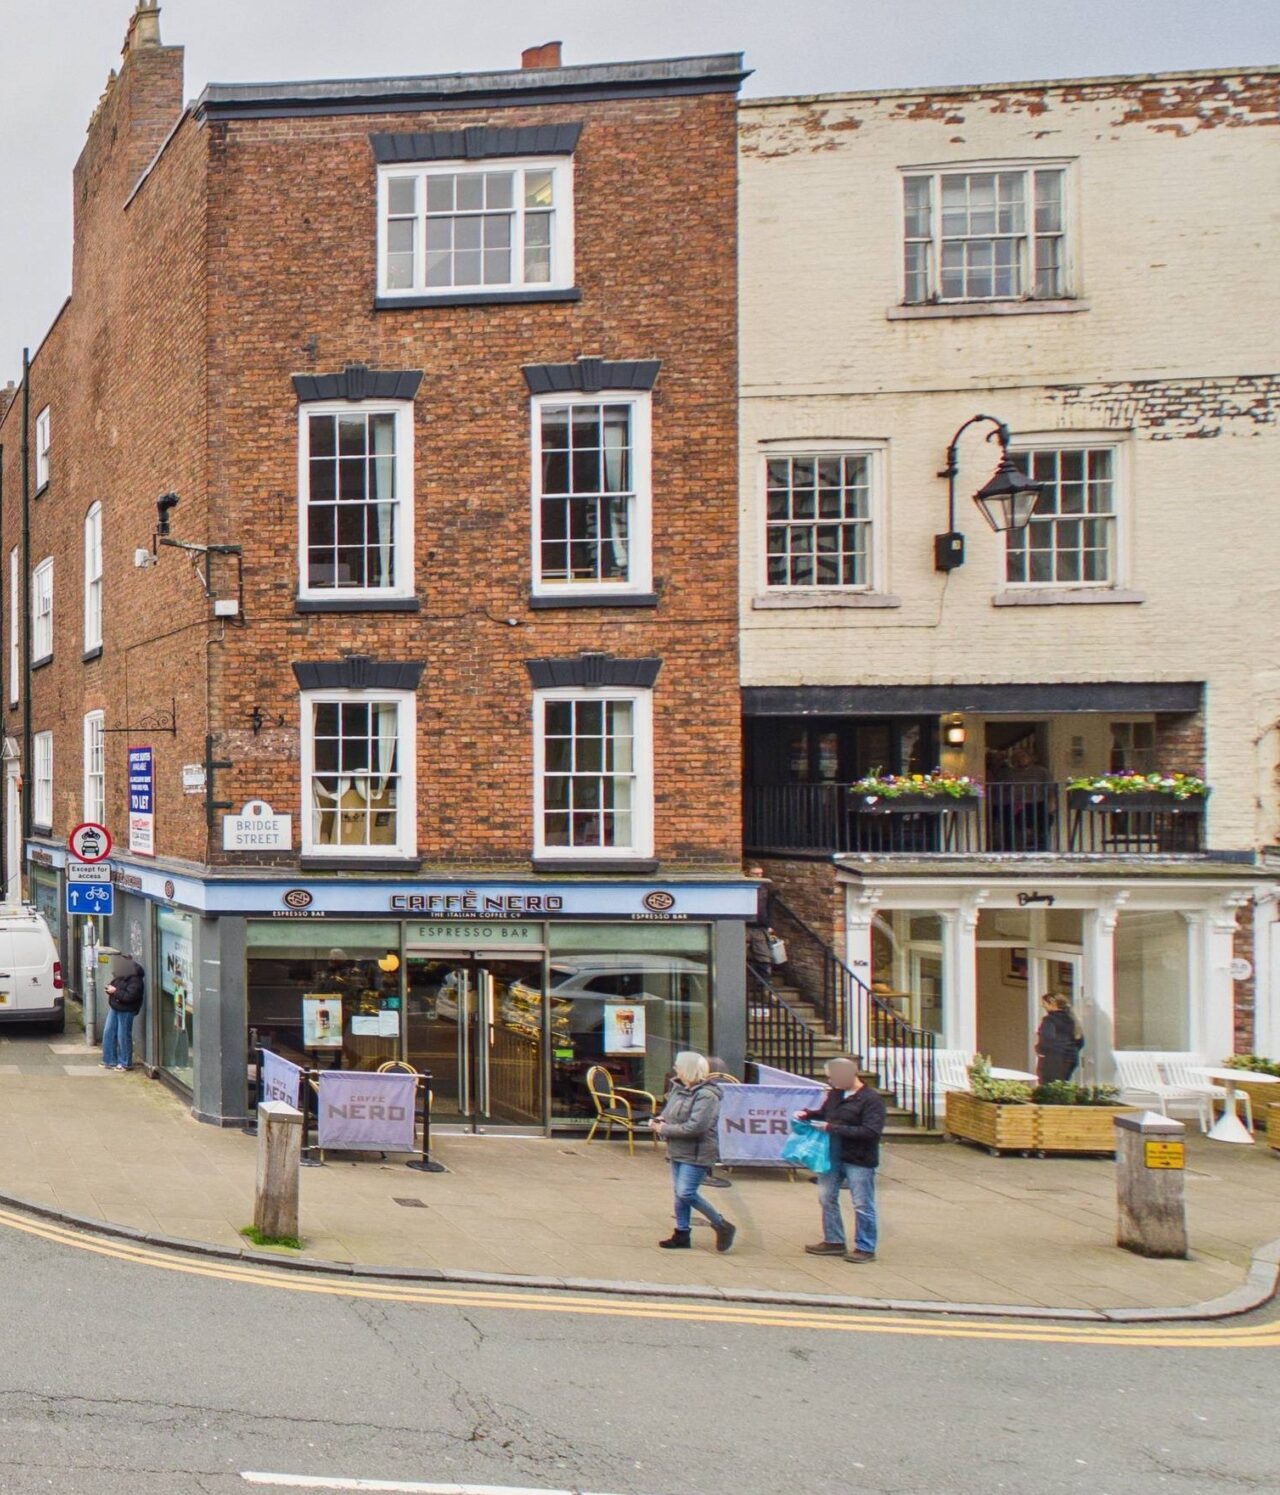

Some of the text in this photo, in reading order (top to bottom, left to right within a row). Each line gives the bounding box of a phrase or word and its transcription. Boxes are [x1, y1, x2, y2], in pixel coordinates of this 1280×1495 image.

[131, 795, 149, 809] TO LET
[236, 820, 280, 830] BRIDGE
[236, 834, 279, 844] STREET
[484, 895, 564, 912] NERO
[420, 927, 529, 938] ESPRESSO BAR
[328, 1104, 406, 1121] NERO
[725, 1118, 788, 1136] NER
